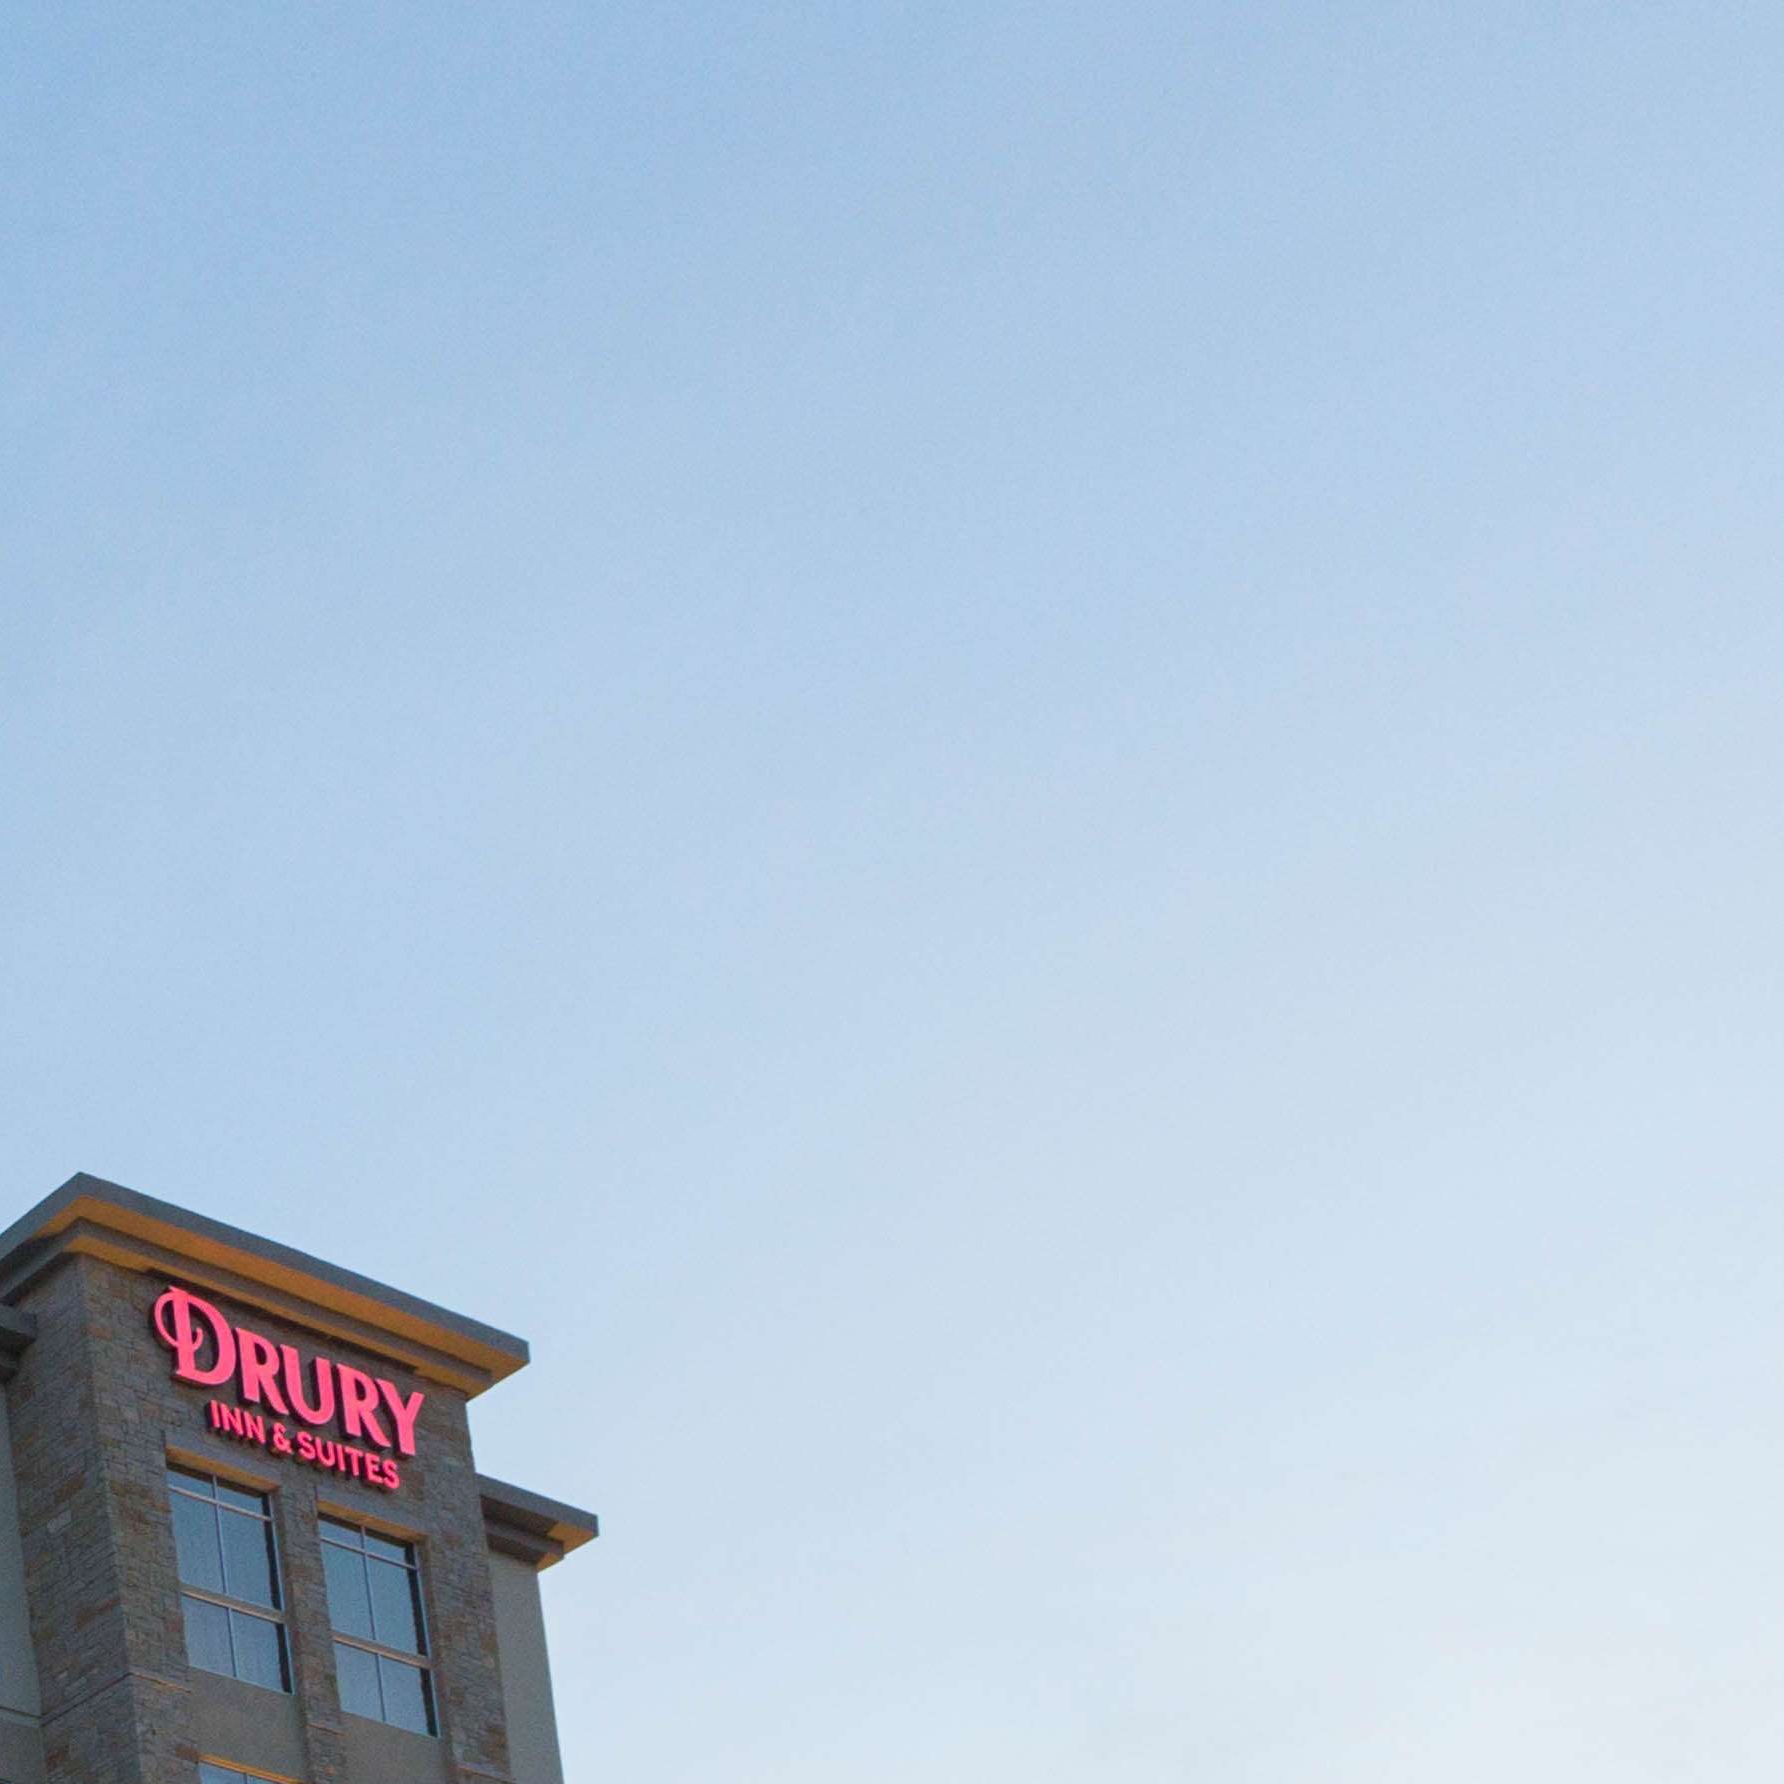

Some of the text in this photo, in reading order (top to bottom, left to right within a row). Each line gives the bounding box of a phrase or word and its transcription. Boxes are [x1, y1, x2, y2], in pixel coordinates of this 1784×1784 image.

[154, 1286, 424, 1455] DRURY
[210, 1400, 400, 1489] INN & SUITES
